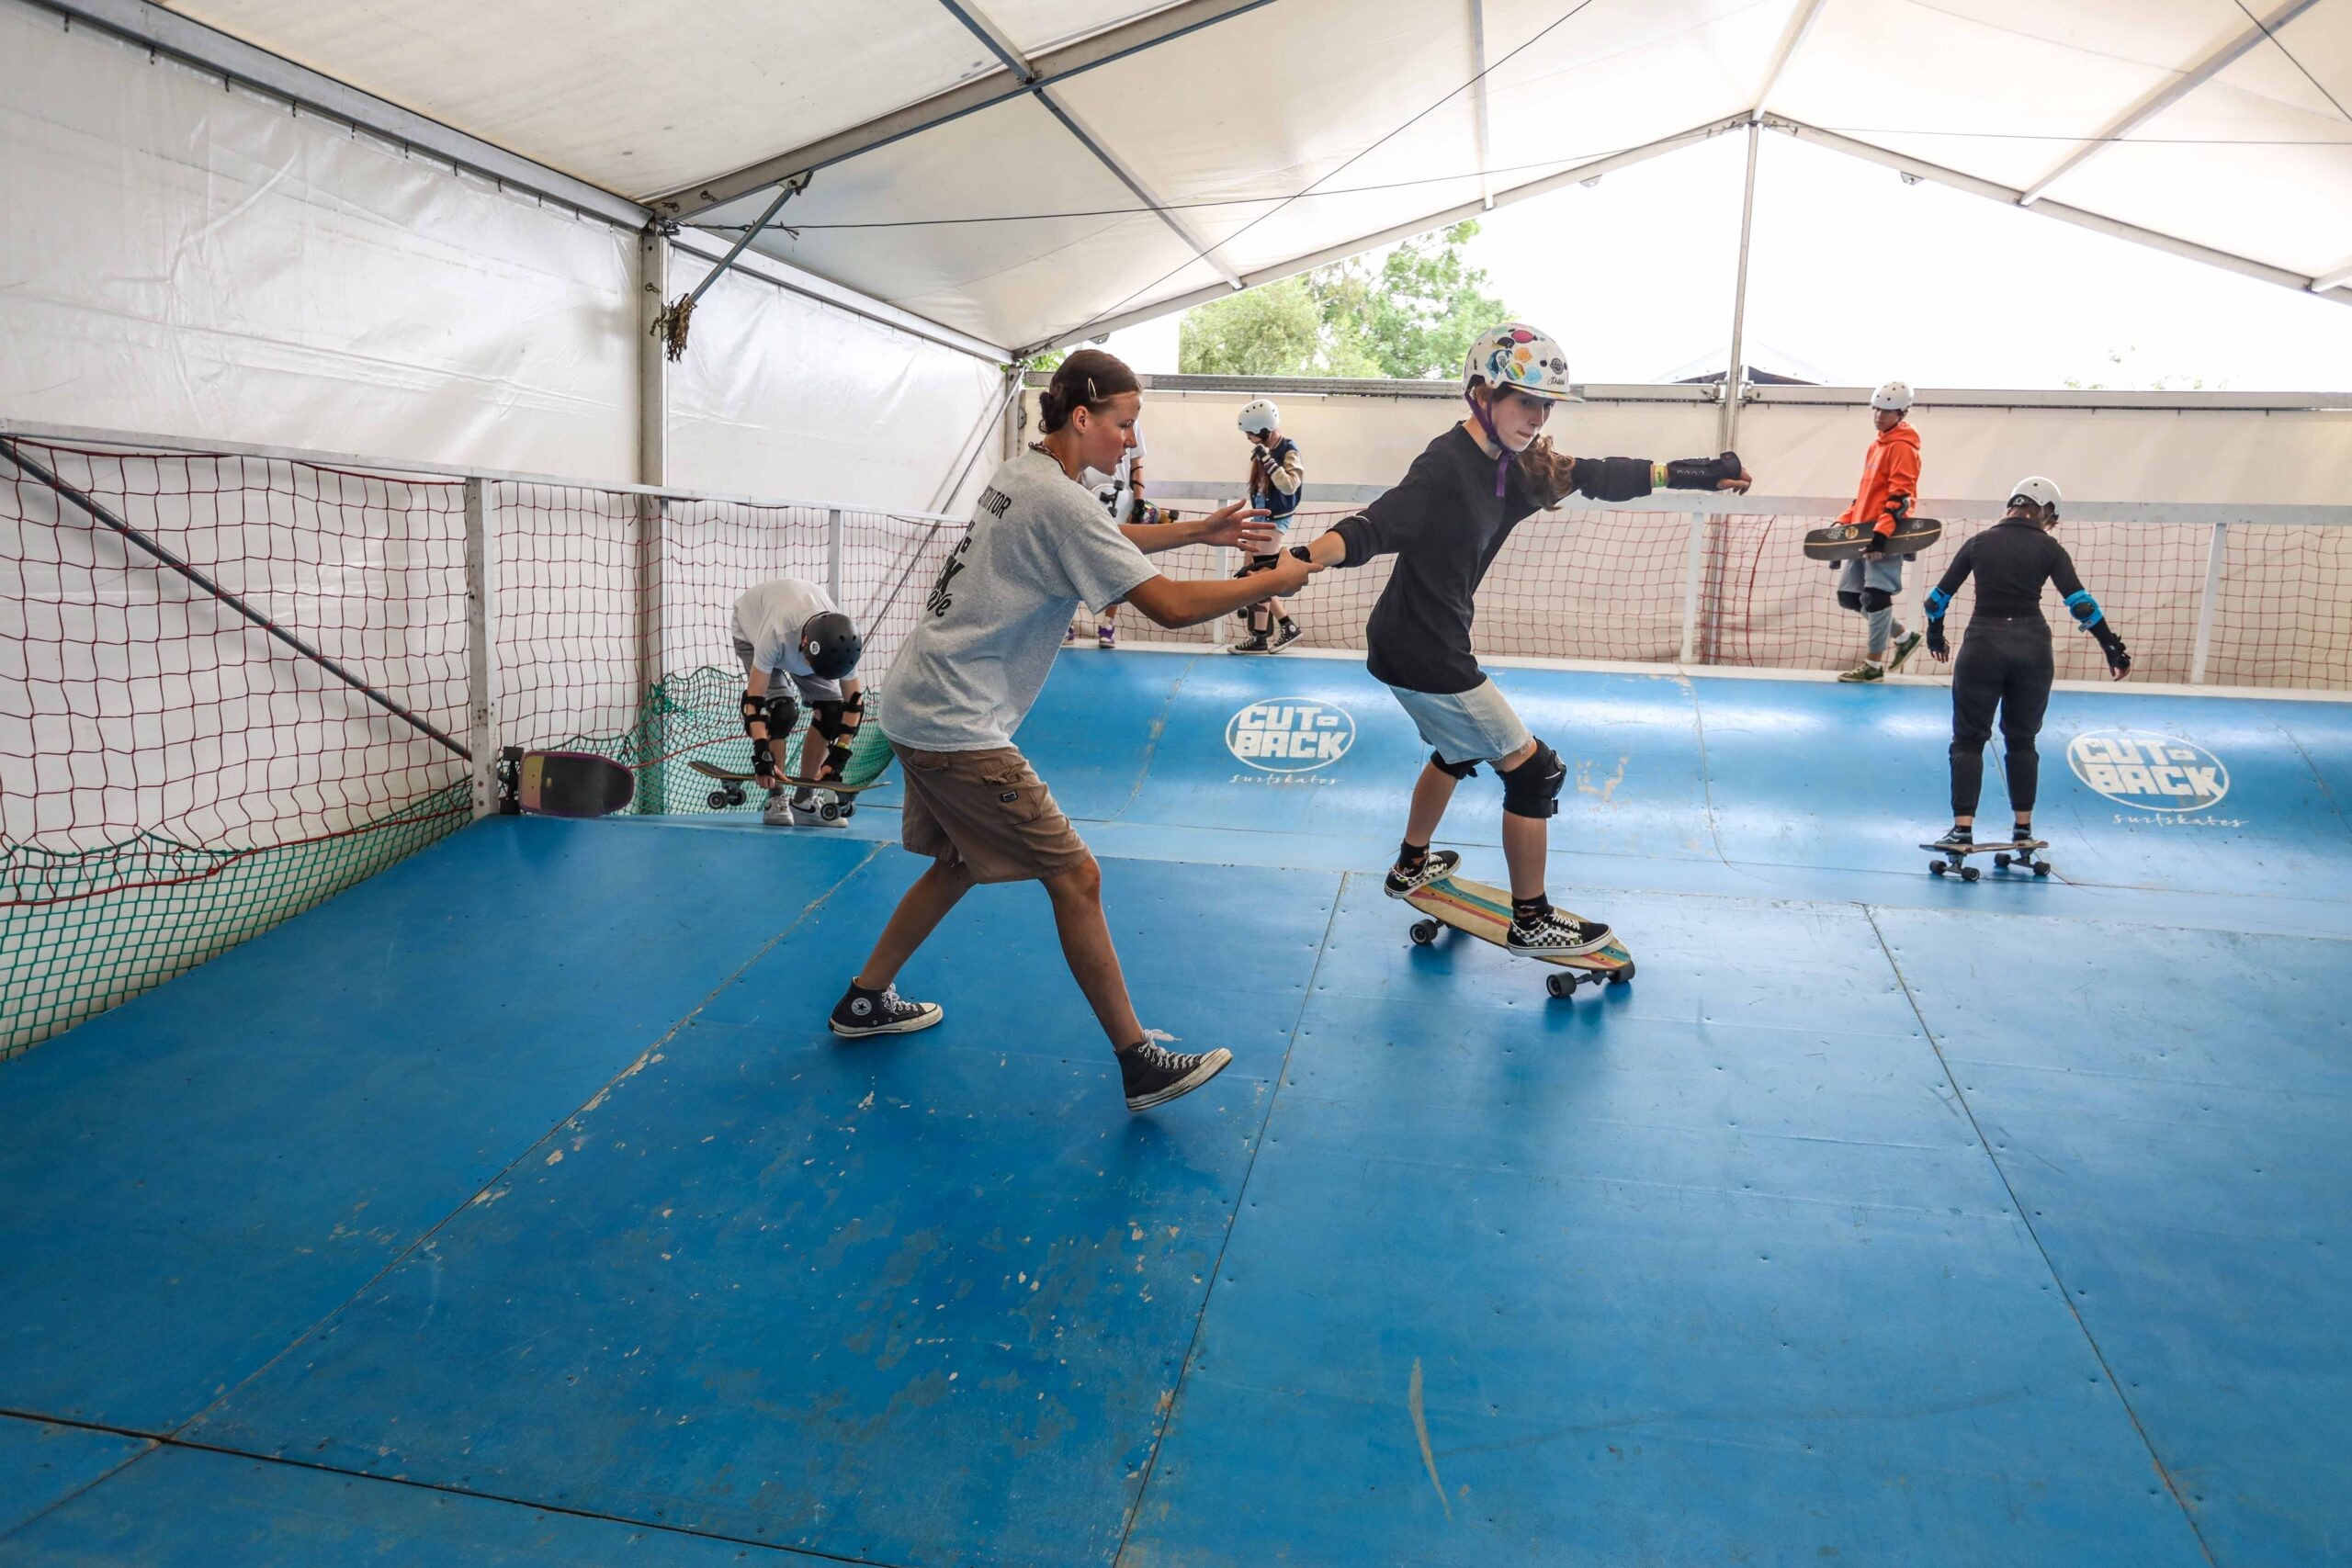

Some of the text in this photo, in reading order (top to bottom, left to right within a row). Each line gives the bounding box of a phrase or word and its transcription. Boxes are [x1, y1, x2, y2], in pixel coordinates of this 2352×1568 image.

[1238, 705, 1339, 731] CUT-
[1234, 730, 1349, 759] BACK
[2073, 738, 2198, 765] CUT-
[1228, 773, 1344, 786] surfskates
[2085, 763, 2226, 797] BACK
[2113, 812, 2249, 828] surfskates
